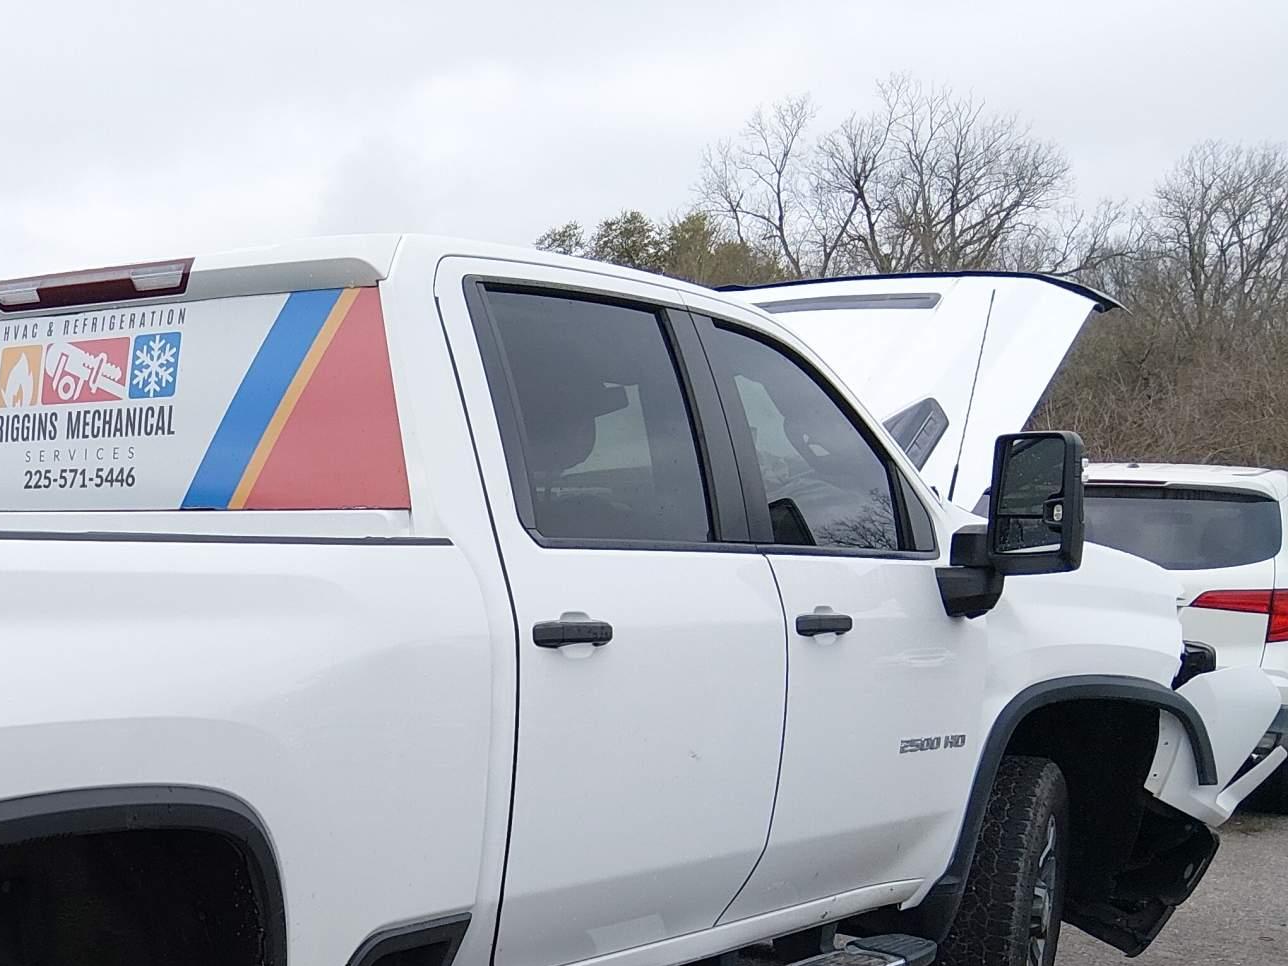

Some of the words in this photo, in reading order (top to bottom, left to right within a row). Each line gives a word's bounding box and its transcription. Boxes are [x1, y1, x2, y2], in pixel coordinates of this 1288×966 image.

[3, 323, 39, 342] HVAC
[46, 321, 55, 337] &
[62, 307, 187, 336] REFRIGERATION
[65, 405, 175, 440] MECHANICAL
[24, 446, 136, 463] SERVICES
[23, 466, 137, 490] 225-571-5446
[899, 736, 941, 754] 2500
[943, 734, 966, 749] HD
